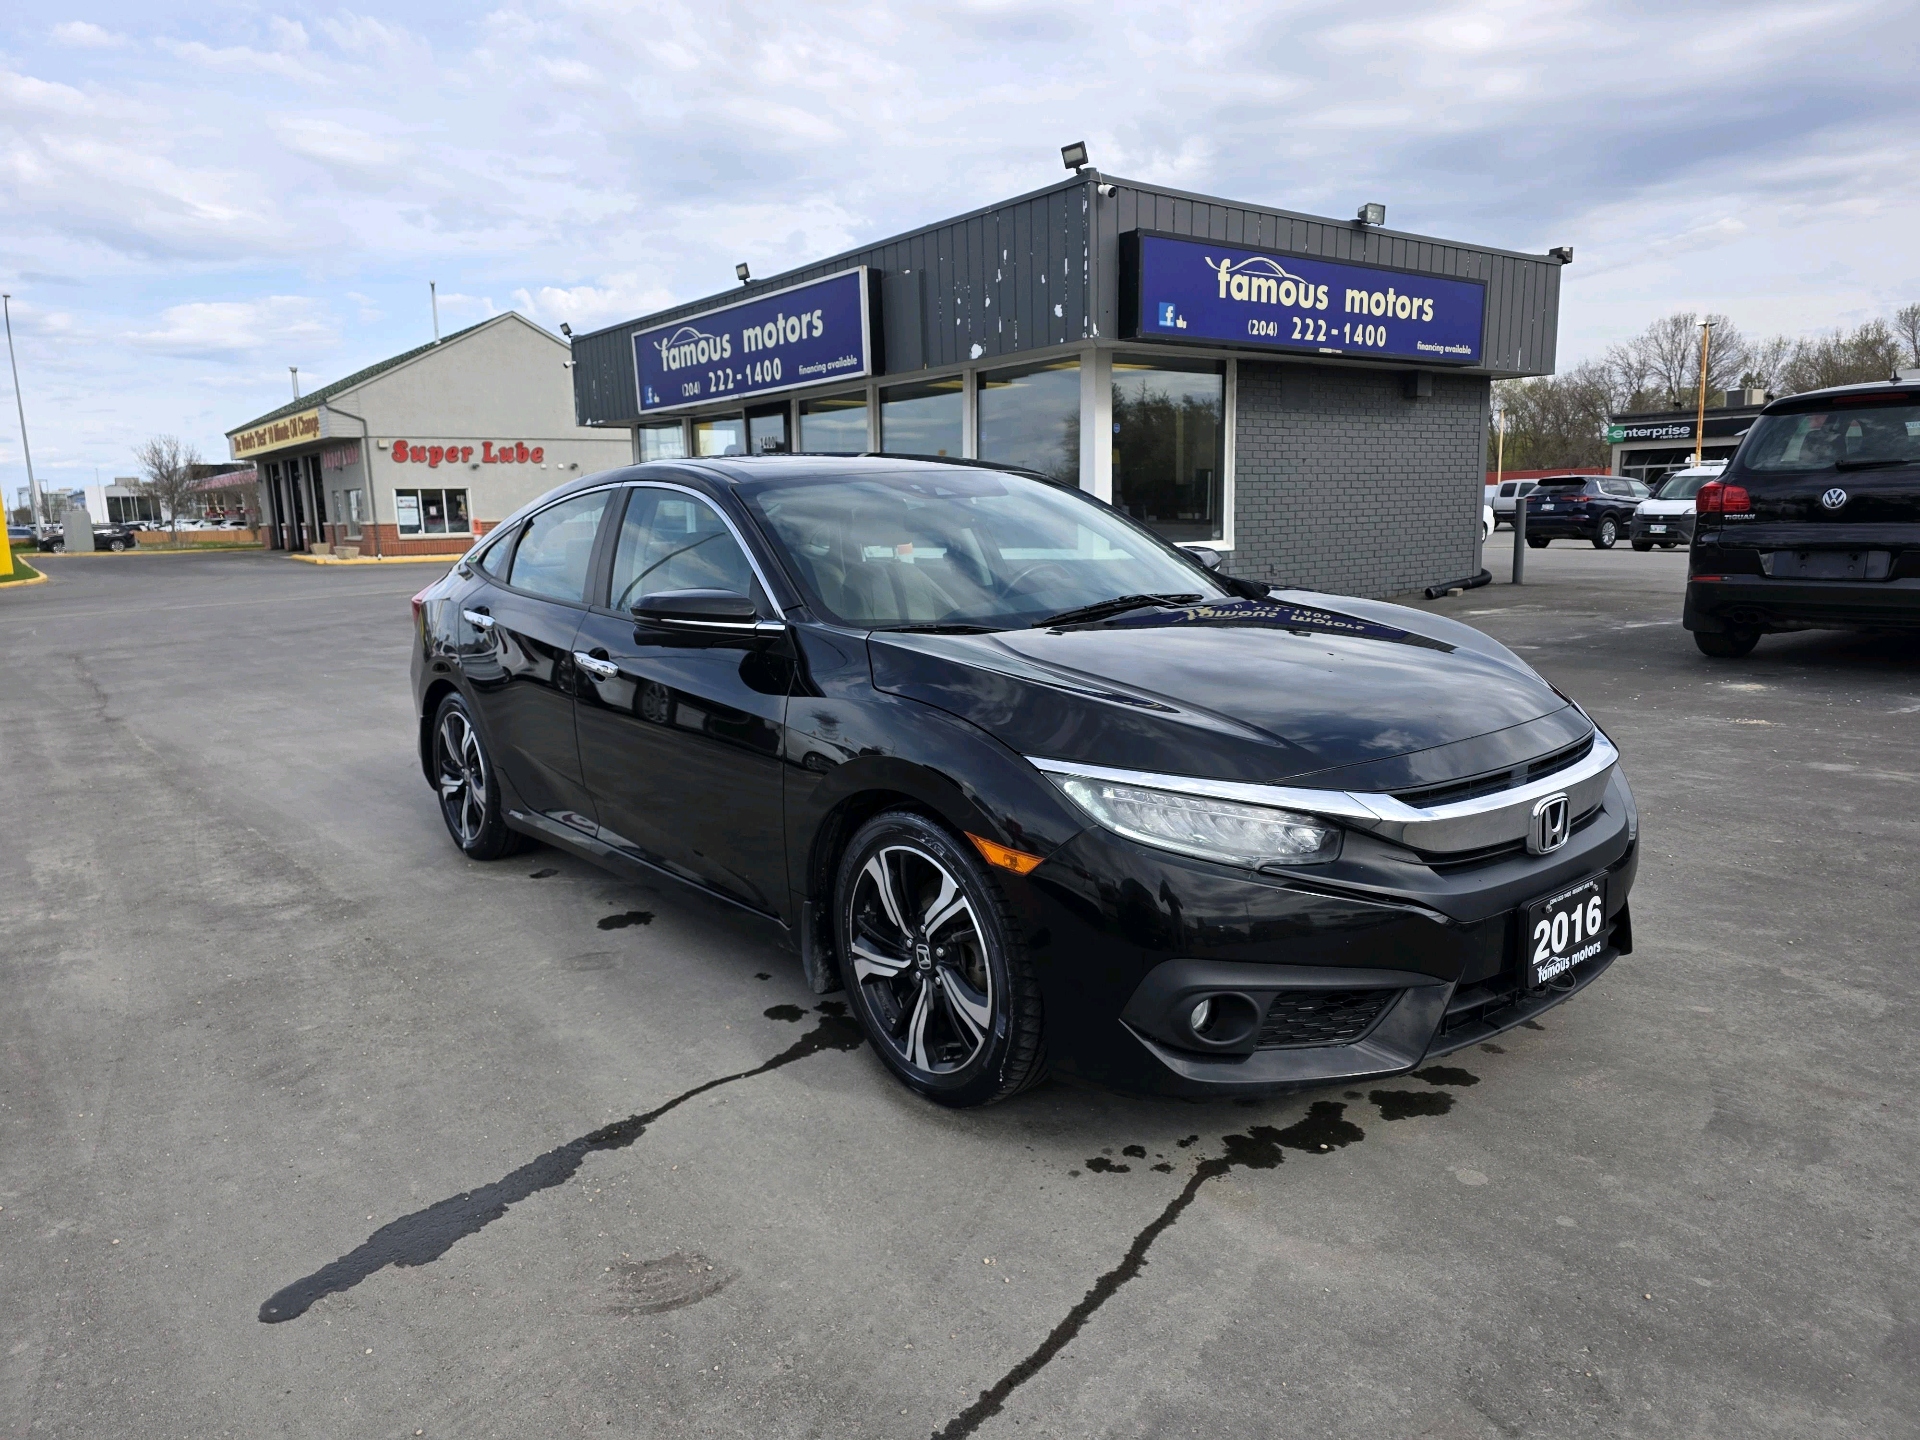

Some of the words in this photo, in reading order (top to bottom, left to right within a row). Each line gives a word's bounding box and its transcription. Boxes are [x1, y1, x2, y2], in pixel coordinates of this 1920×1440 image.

[1217, 258, 1329, 310] famous
[1344, 287, 1434, 322] motors
[661, 332, 731, 372] famous
[743, 309, 824, 353] motors
[1248, 319, 1278, 337] (204)
[1291, 316, 1387, 347] 222-1400
[1417, 340, 1444, 354] financing
[1445, 344, 1472, 354] available
[681, 381, 701, 397] (204)
[708, 357, 782, 393] 222-1400
[798, 361, 827, 375] financing
[827, 354, 858, 370] available
[289, 418, 298, 439] Oil
[298, 416, 320, 438] Change
[1610, 425, 1691, 439] enterprise
[392, 440, 474, 468] Super
[481, 441, 545, 464] Lube
[1533, 895, 1602, 965] 2016
[1538, 957, 1570, 984] famous
[1572, 941, 1602, 966] motors
